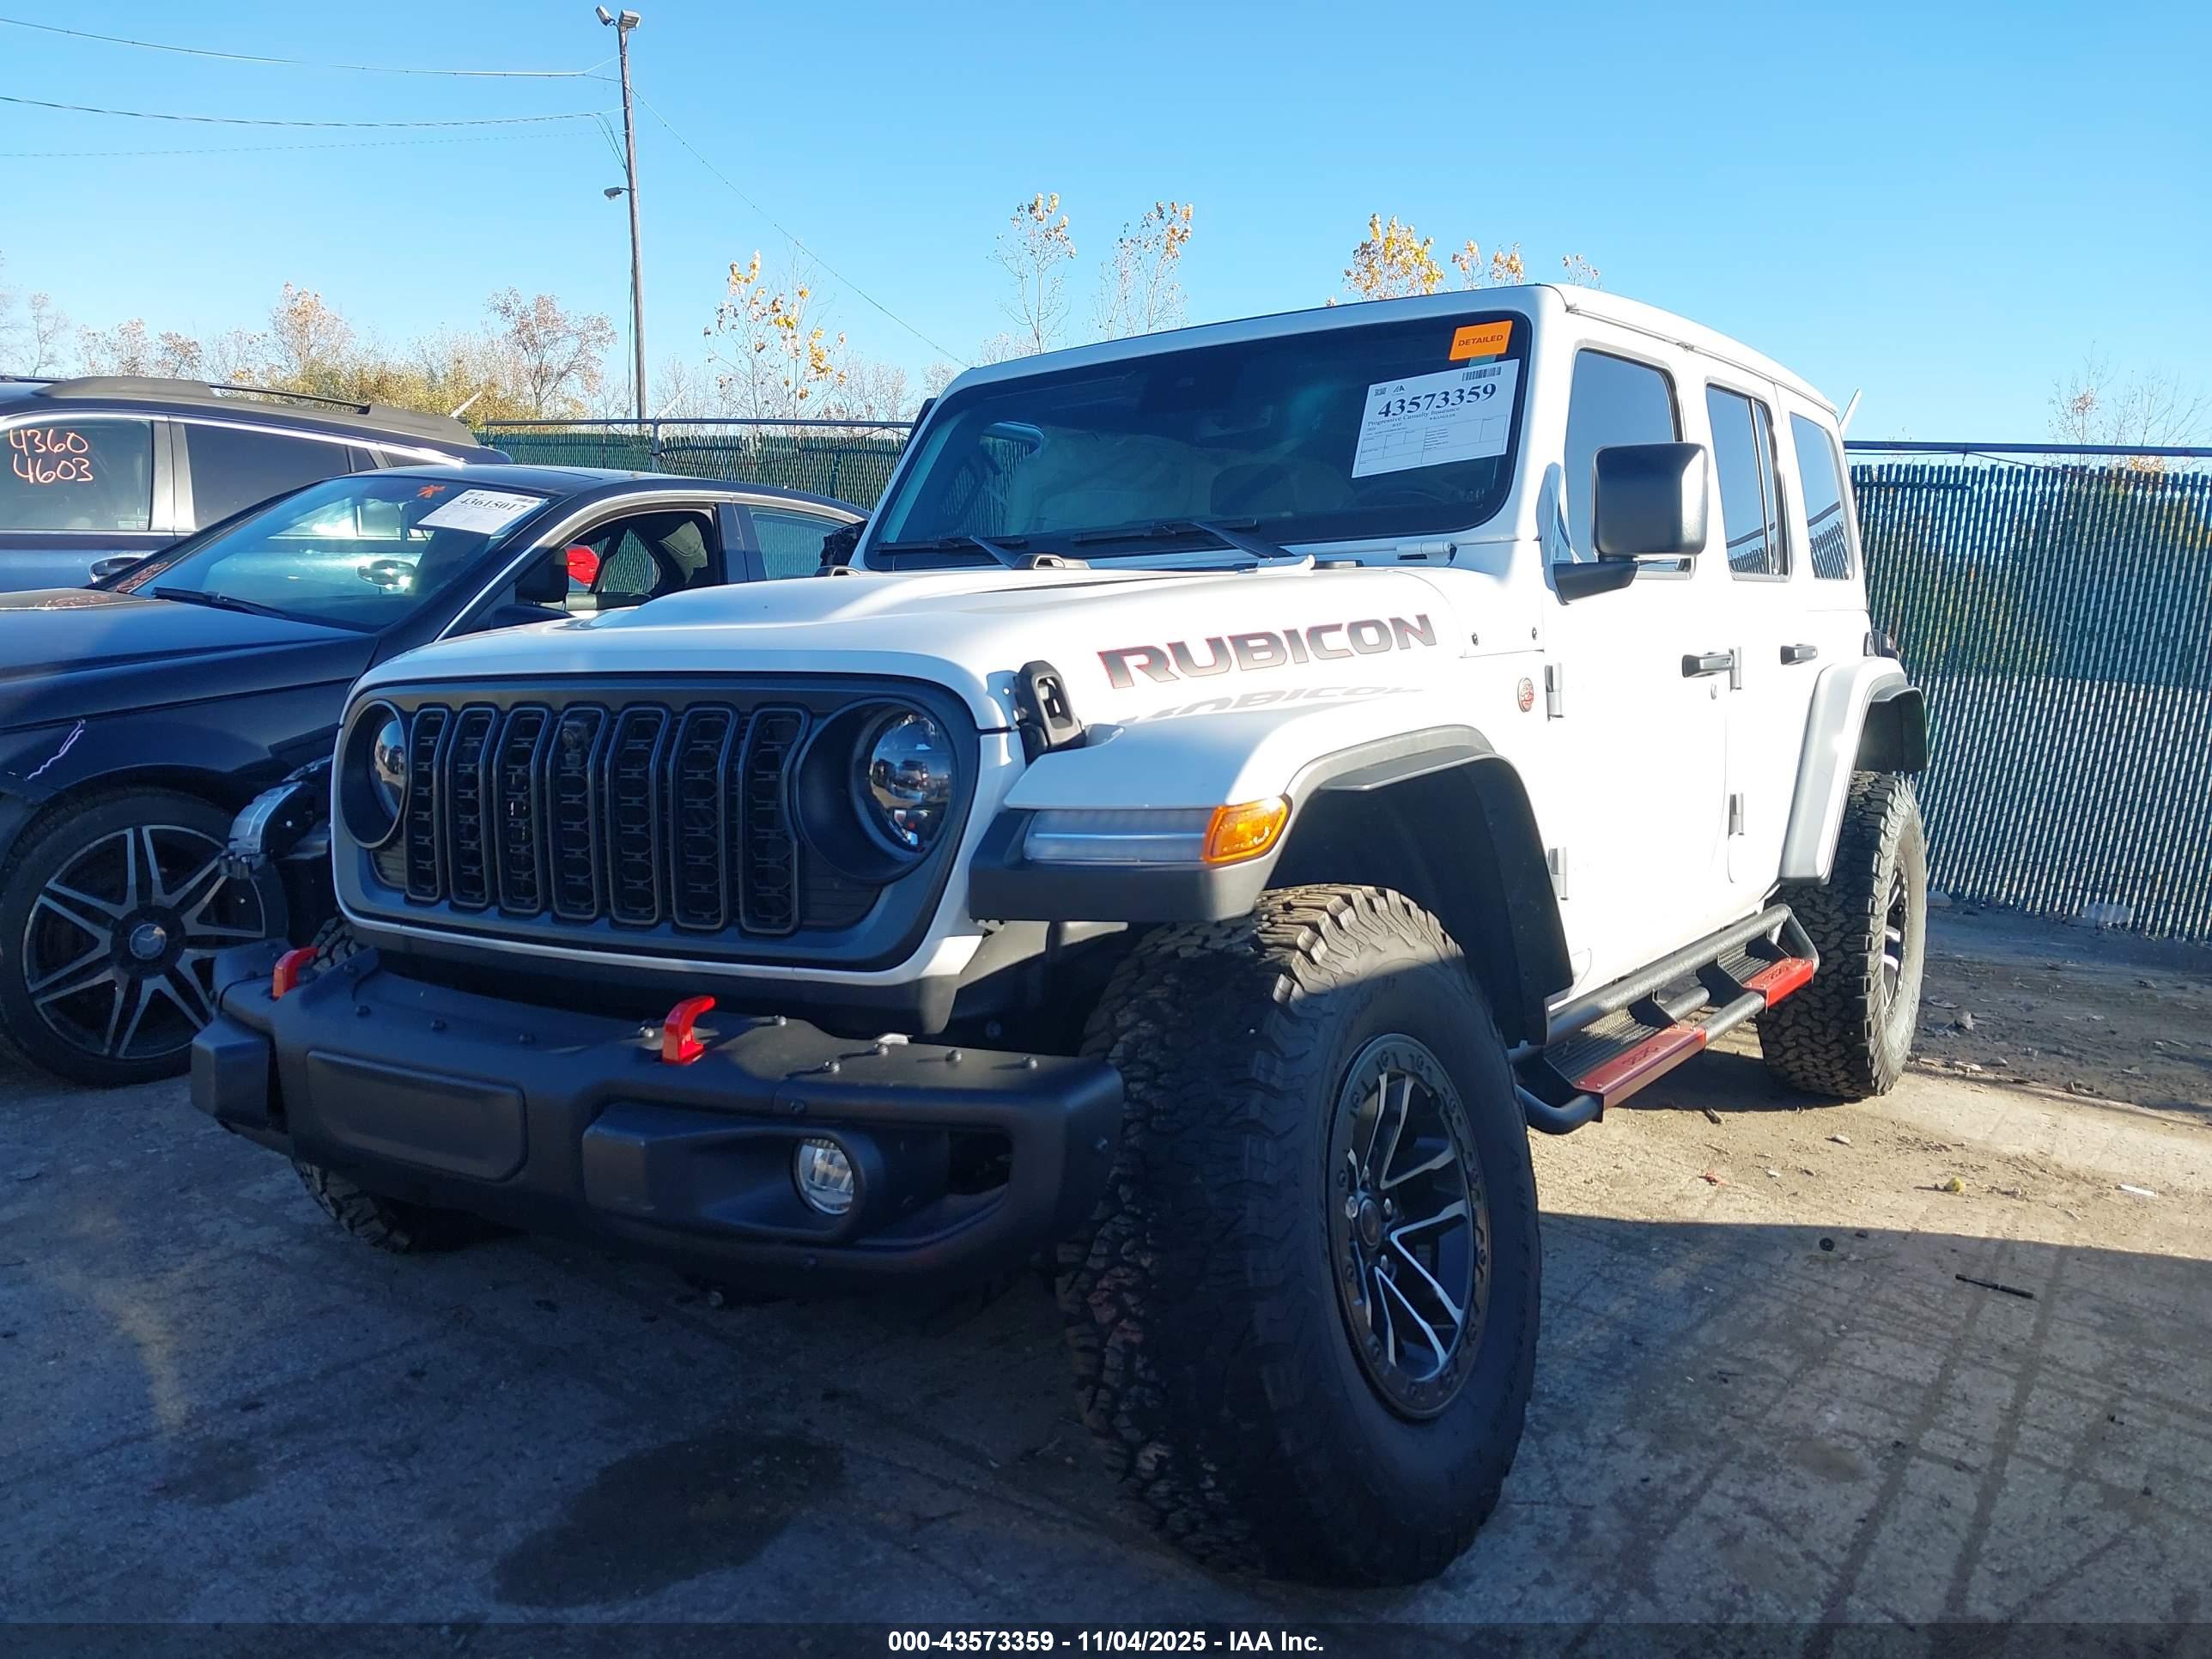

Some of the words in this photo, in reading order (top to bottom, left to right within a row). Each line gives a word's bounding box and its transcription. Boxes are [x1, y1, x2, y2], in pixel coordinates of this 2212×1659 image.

[1458, 334, 1504, 346] DETAILED
[1378, 383, 1497, 417] 43573359
[9, 428, 88, 456] 4360
[13, 453, 94, 483] 4603
[459, 497, 527, 513] 43615017
[1097, 614, 1437, 689] RUBICON
